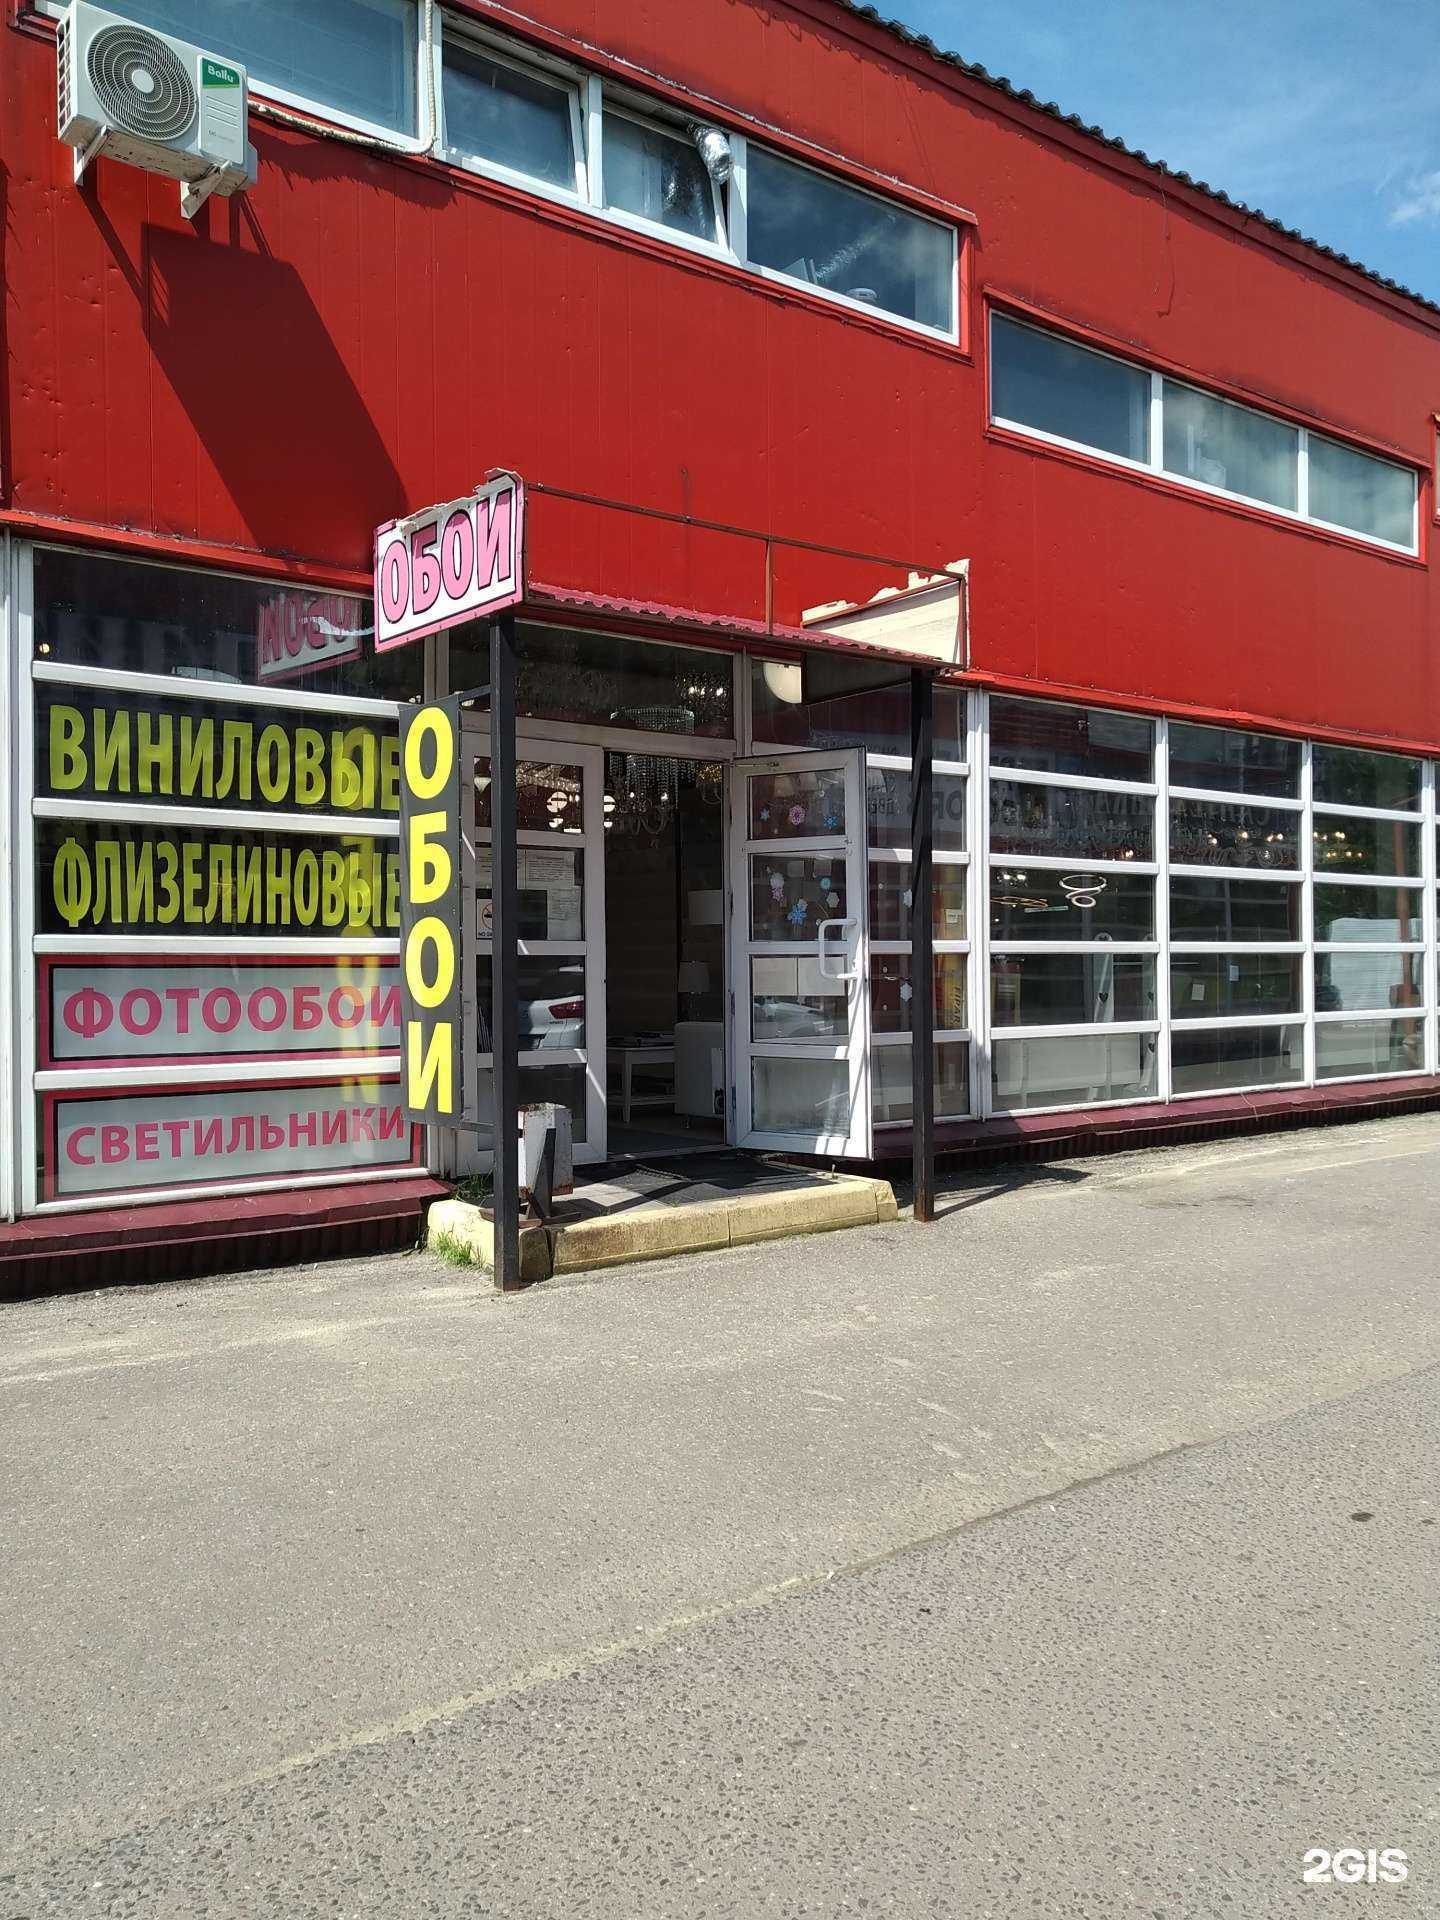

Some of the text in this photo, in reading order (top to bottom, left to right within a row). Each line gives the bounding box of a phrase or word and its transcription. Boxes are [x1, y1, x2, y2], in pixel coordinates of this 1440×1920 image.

[207, 64, 234, 83] Ballu
[381, 487, 513, 625] ОБОИ
[50, 705, 400, 811] ВИНИЛОВЫЕ
[53, 837, 400, 928] ФЛИЗЕЛИНОВЫЕ
[404, 706, 455, 1114] ОБОИ
[62, 986, 401, 1039] ФОТООБОИ
[66, 1106, 405, 1167] СВЕТИЛЬНИКИ
